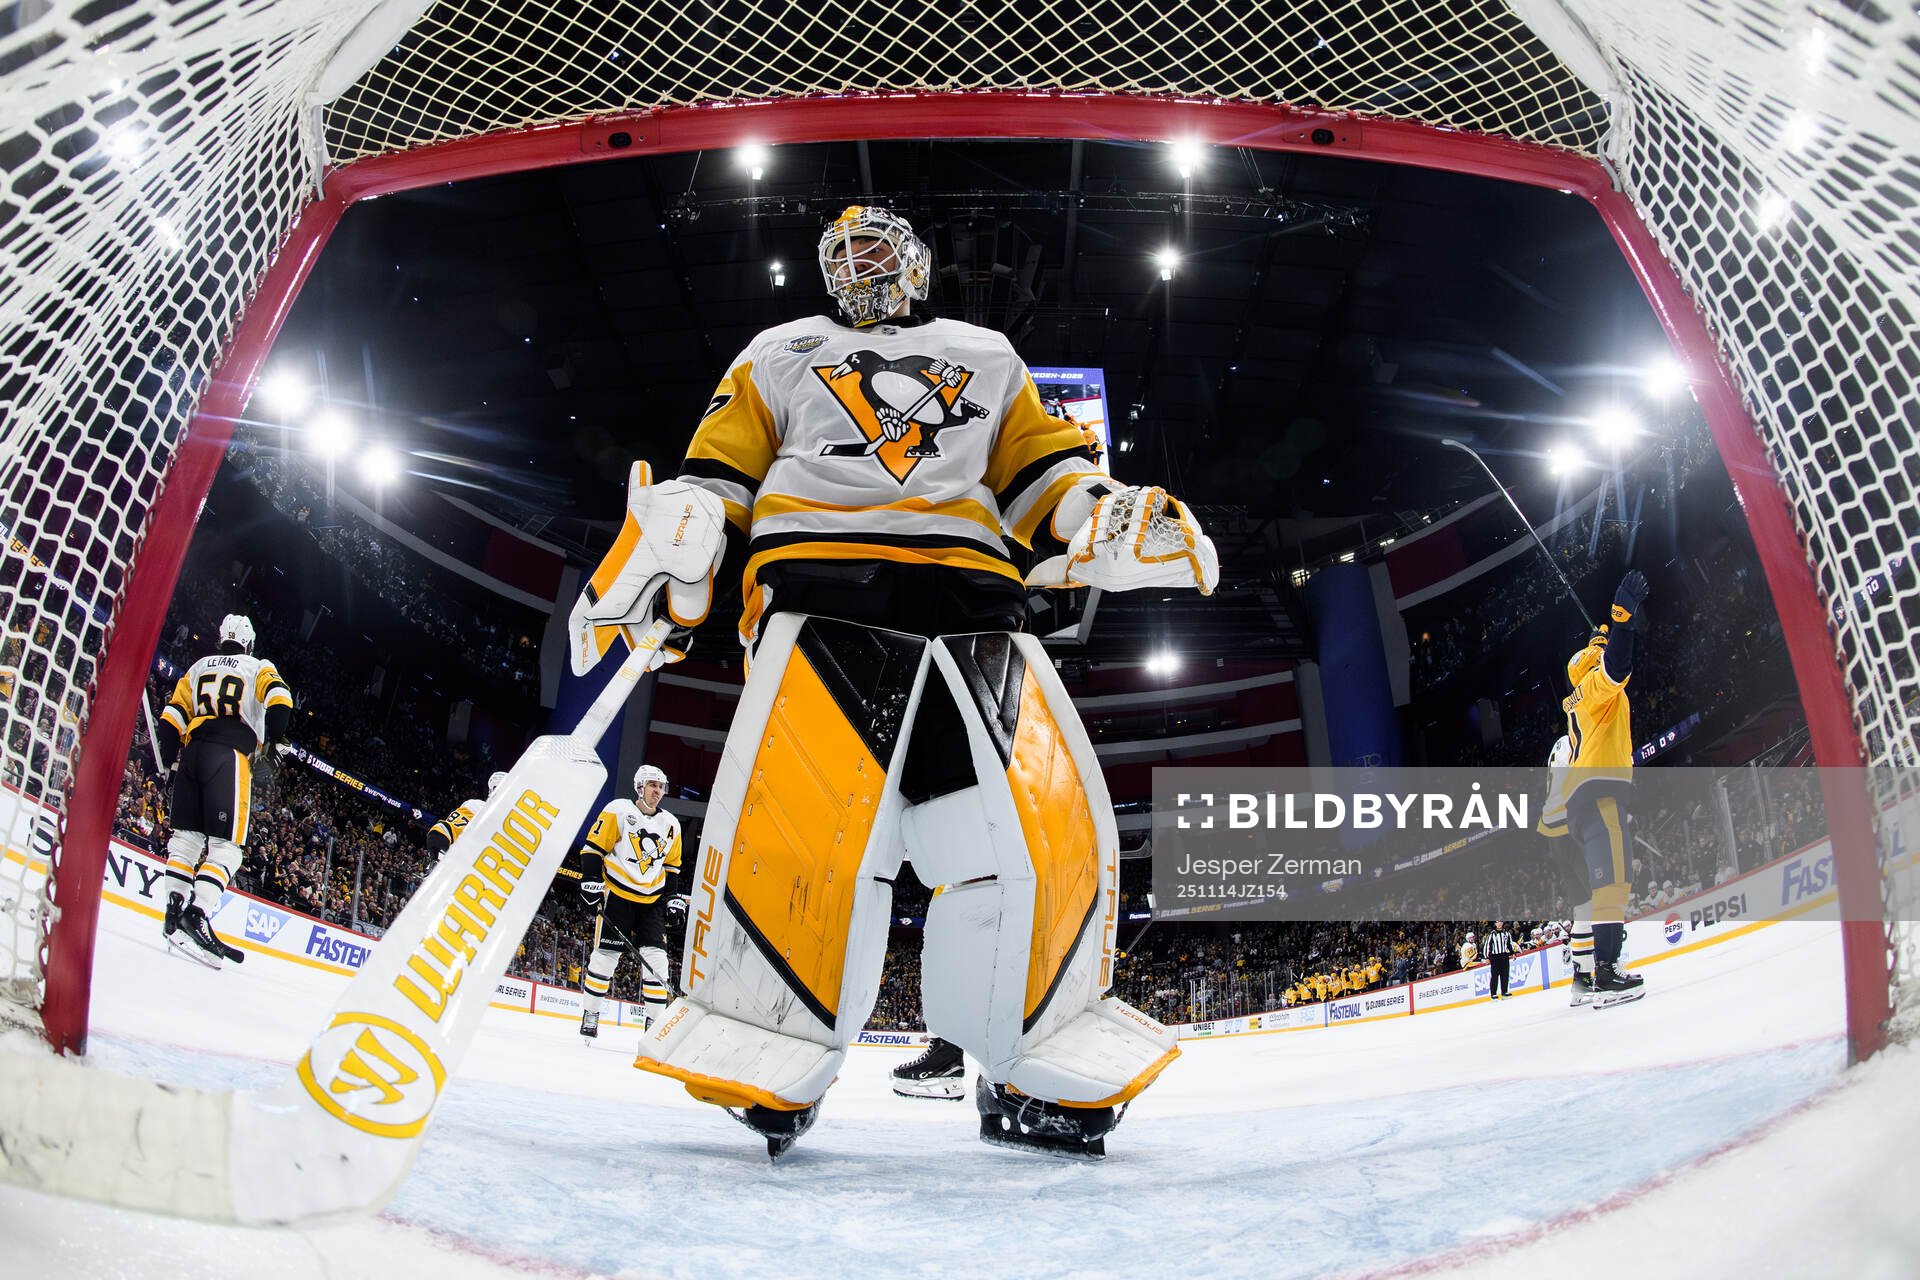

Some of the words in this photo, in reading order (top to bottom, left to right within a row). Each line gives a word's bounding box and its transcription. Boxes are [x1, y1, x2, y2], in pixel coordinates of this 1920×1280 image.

[207, 657, 239, 669] LETANG
[197, 673, 245, 719] 58
[1641, 745, 1656, 760] 1:10
[334, 770, 365, 791] SERIES
[447, 811, 469, 833] 87
[667, 825, 674, 840] A
[1443, 838, 1467, 854] SERIES
[557, 866, 583, 880] SERIES
[394, 789, 560, 1023] WARRIOR
[1160, 907, 1191, 918] GLOBAL
[1190, 903, 1221, 914] SERIES
[1690, 892, 1748, 931] PEPSI
[248, 908, 280, 939] SAP
[689, 845, 724, 990] TRUE
[1099, 848, 1117, 987] TRUE
[1664, 922, 1683, 934] PEPSI
[505, 986, 527, 999] SERIES
[630, 1005, 646, 1017] UNIBE
[1330, 1002, 1361, 1020] FASTENAL
[1386, 995, 1405, 1007] SERIES
[1193, 1022, 1215, 1032] UNIBET
[857, 1032, 911, 1045] FASTENAL
